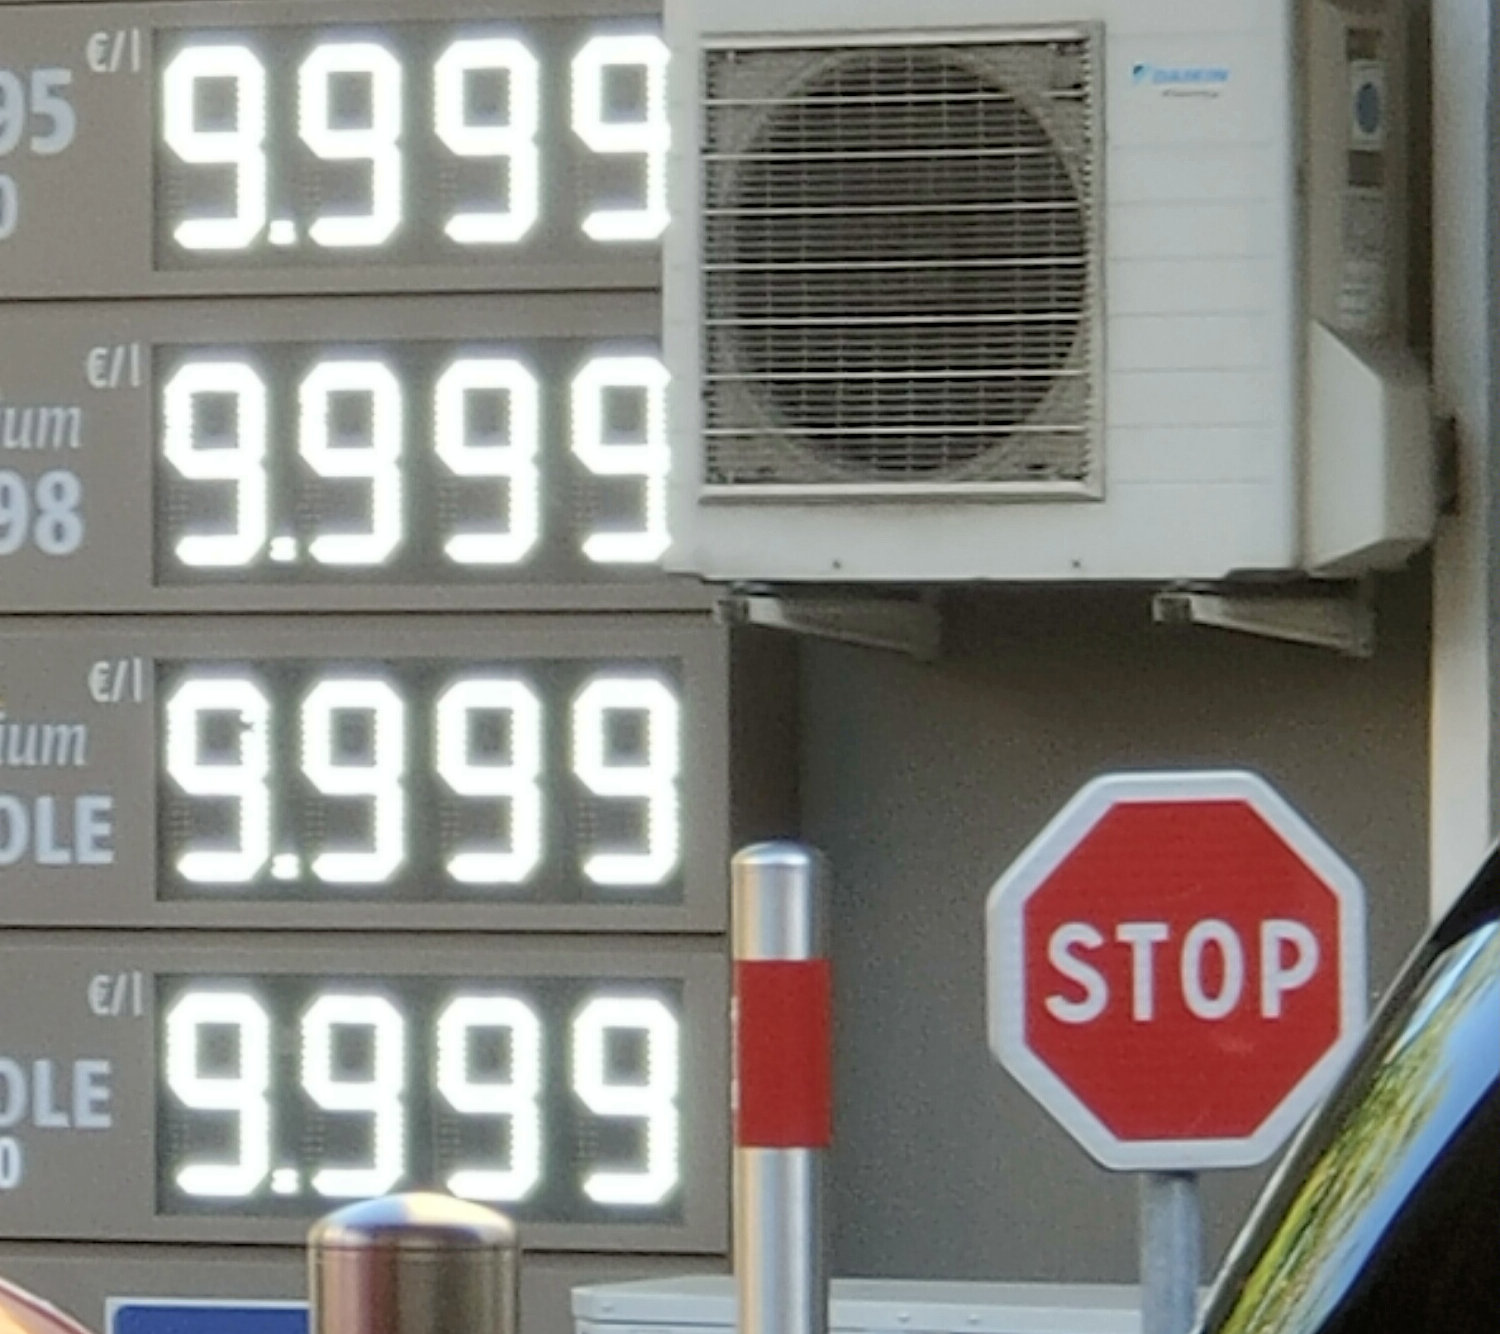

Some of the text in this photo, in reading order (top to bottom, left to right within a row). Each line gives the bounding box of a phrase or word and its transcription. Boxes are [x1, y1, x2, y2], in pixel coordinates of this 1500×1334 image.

[162, 34, 672, 249] 9.999
[162, 356, 672, 566] 9.999
[165, 677, 679, 884] 9.999
[1045, 918, 1320, 1024] STOP
[165, 992, 679, 1204] 9.999
